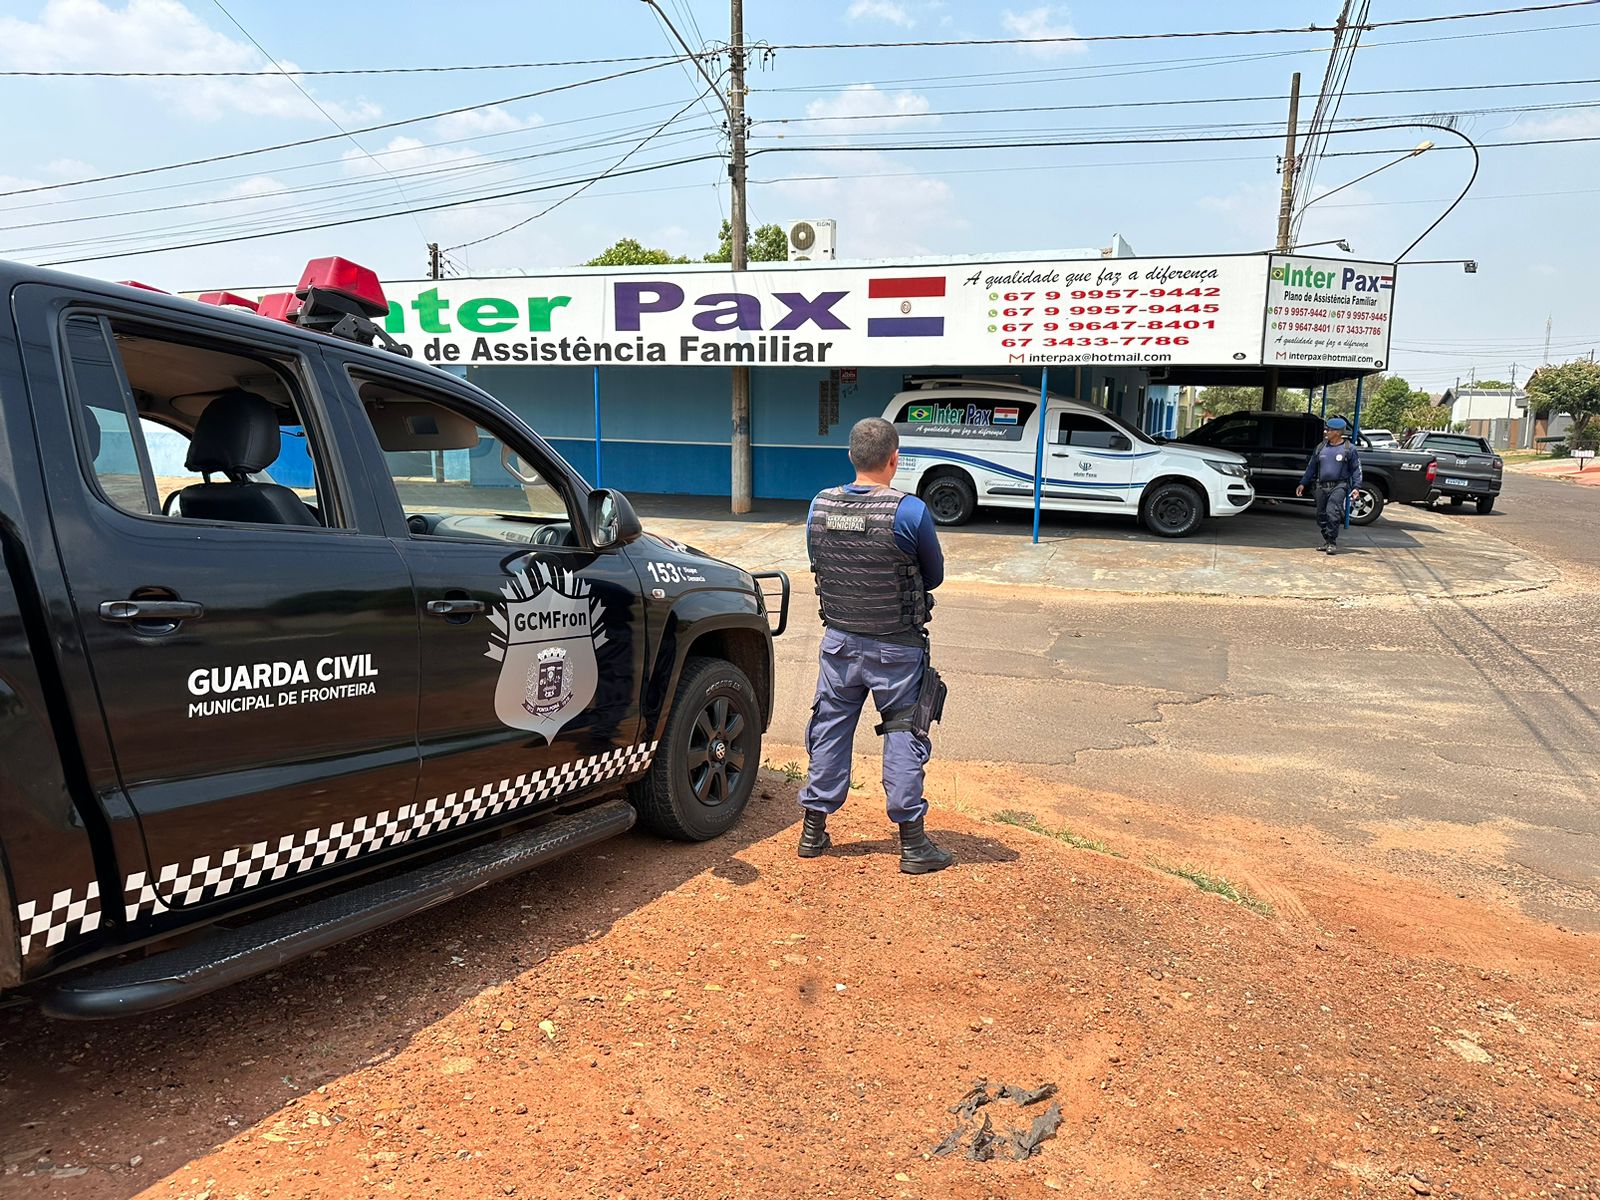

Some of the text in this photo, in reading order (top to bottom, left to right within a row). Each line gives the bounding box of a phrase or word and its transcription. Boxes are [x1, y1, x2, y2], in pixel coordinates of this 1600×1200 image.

[963, 266, 1219, 289] A qualidade que faz a diferença
[1283, 263, 1380, 292] Inter Pax
[1003, 287, 1221, 302] 67 9 9957-9442
[1284, 290, 1378, 306] Plano de Assistência Familiar
[385, 281, 851, 334] ter Pax
[1002, 303, 1220, 317] 67 9 9957-9445
[1273, 306, 1283, 315] 67
[1284, 307, 1289, 316] 9
[1290, 307, 1327, 318] 9957-9442
[1336, 310, 1345, 319] 67
[1346, 310, 1351, 319] 9
[1352, 311, 1387, 322] 9957-9445
[1001, 319, 1216, 333] 67 9 9647-8401
[1277, 321, 1287, 330] 67
[1288, 322, 1293, 331] 9
[1294, 322, 1330, 333] 9647-8401
[1336, 325, 1345, 334] 67
[1346, 325, 1381, 336] 3433-7786
[423, 337, 460, 362] de
[471, 335, 667, 363] Assistência
[680, 335, 834, 363] Familiar
[1001, 336, 1190, 348] 67 3433-7786
[1283, 336, 1313, 345] qualidade
[1314, 339, 1325, 347] que
[1343, 339, 1369, 349] diferença
[1028, 352, 1172, 364] interpax@hotmail.com
[1288, 351, 1374, 363] interpax@hotmail.com
[932, 403, 991, 426] Inter Pax
[827, 521, 864, 530] MUNICIPAL
[647, 561, 680, 583] 153
[514, 610, 587, 632] GCMFron
[187, 653, 379, 696] GUARDA CIVIL
[188, 681, 376, 718] MUNICIPAL DE FRONTEIRA
